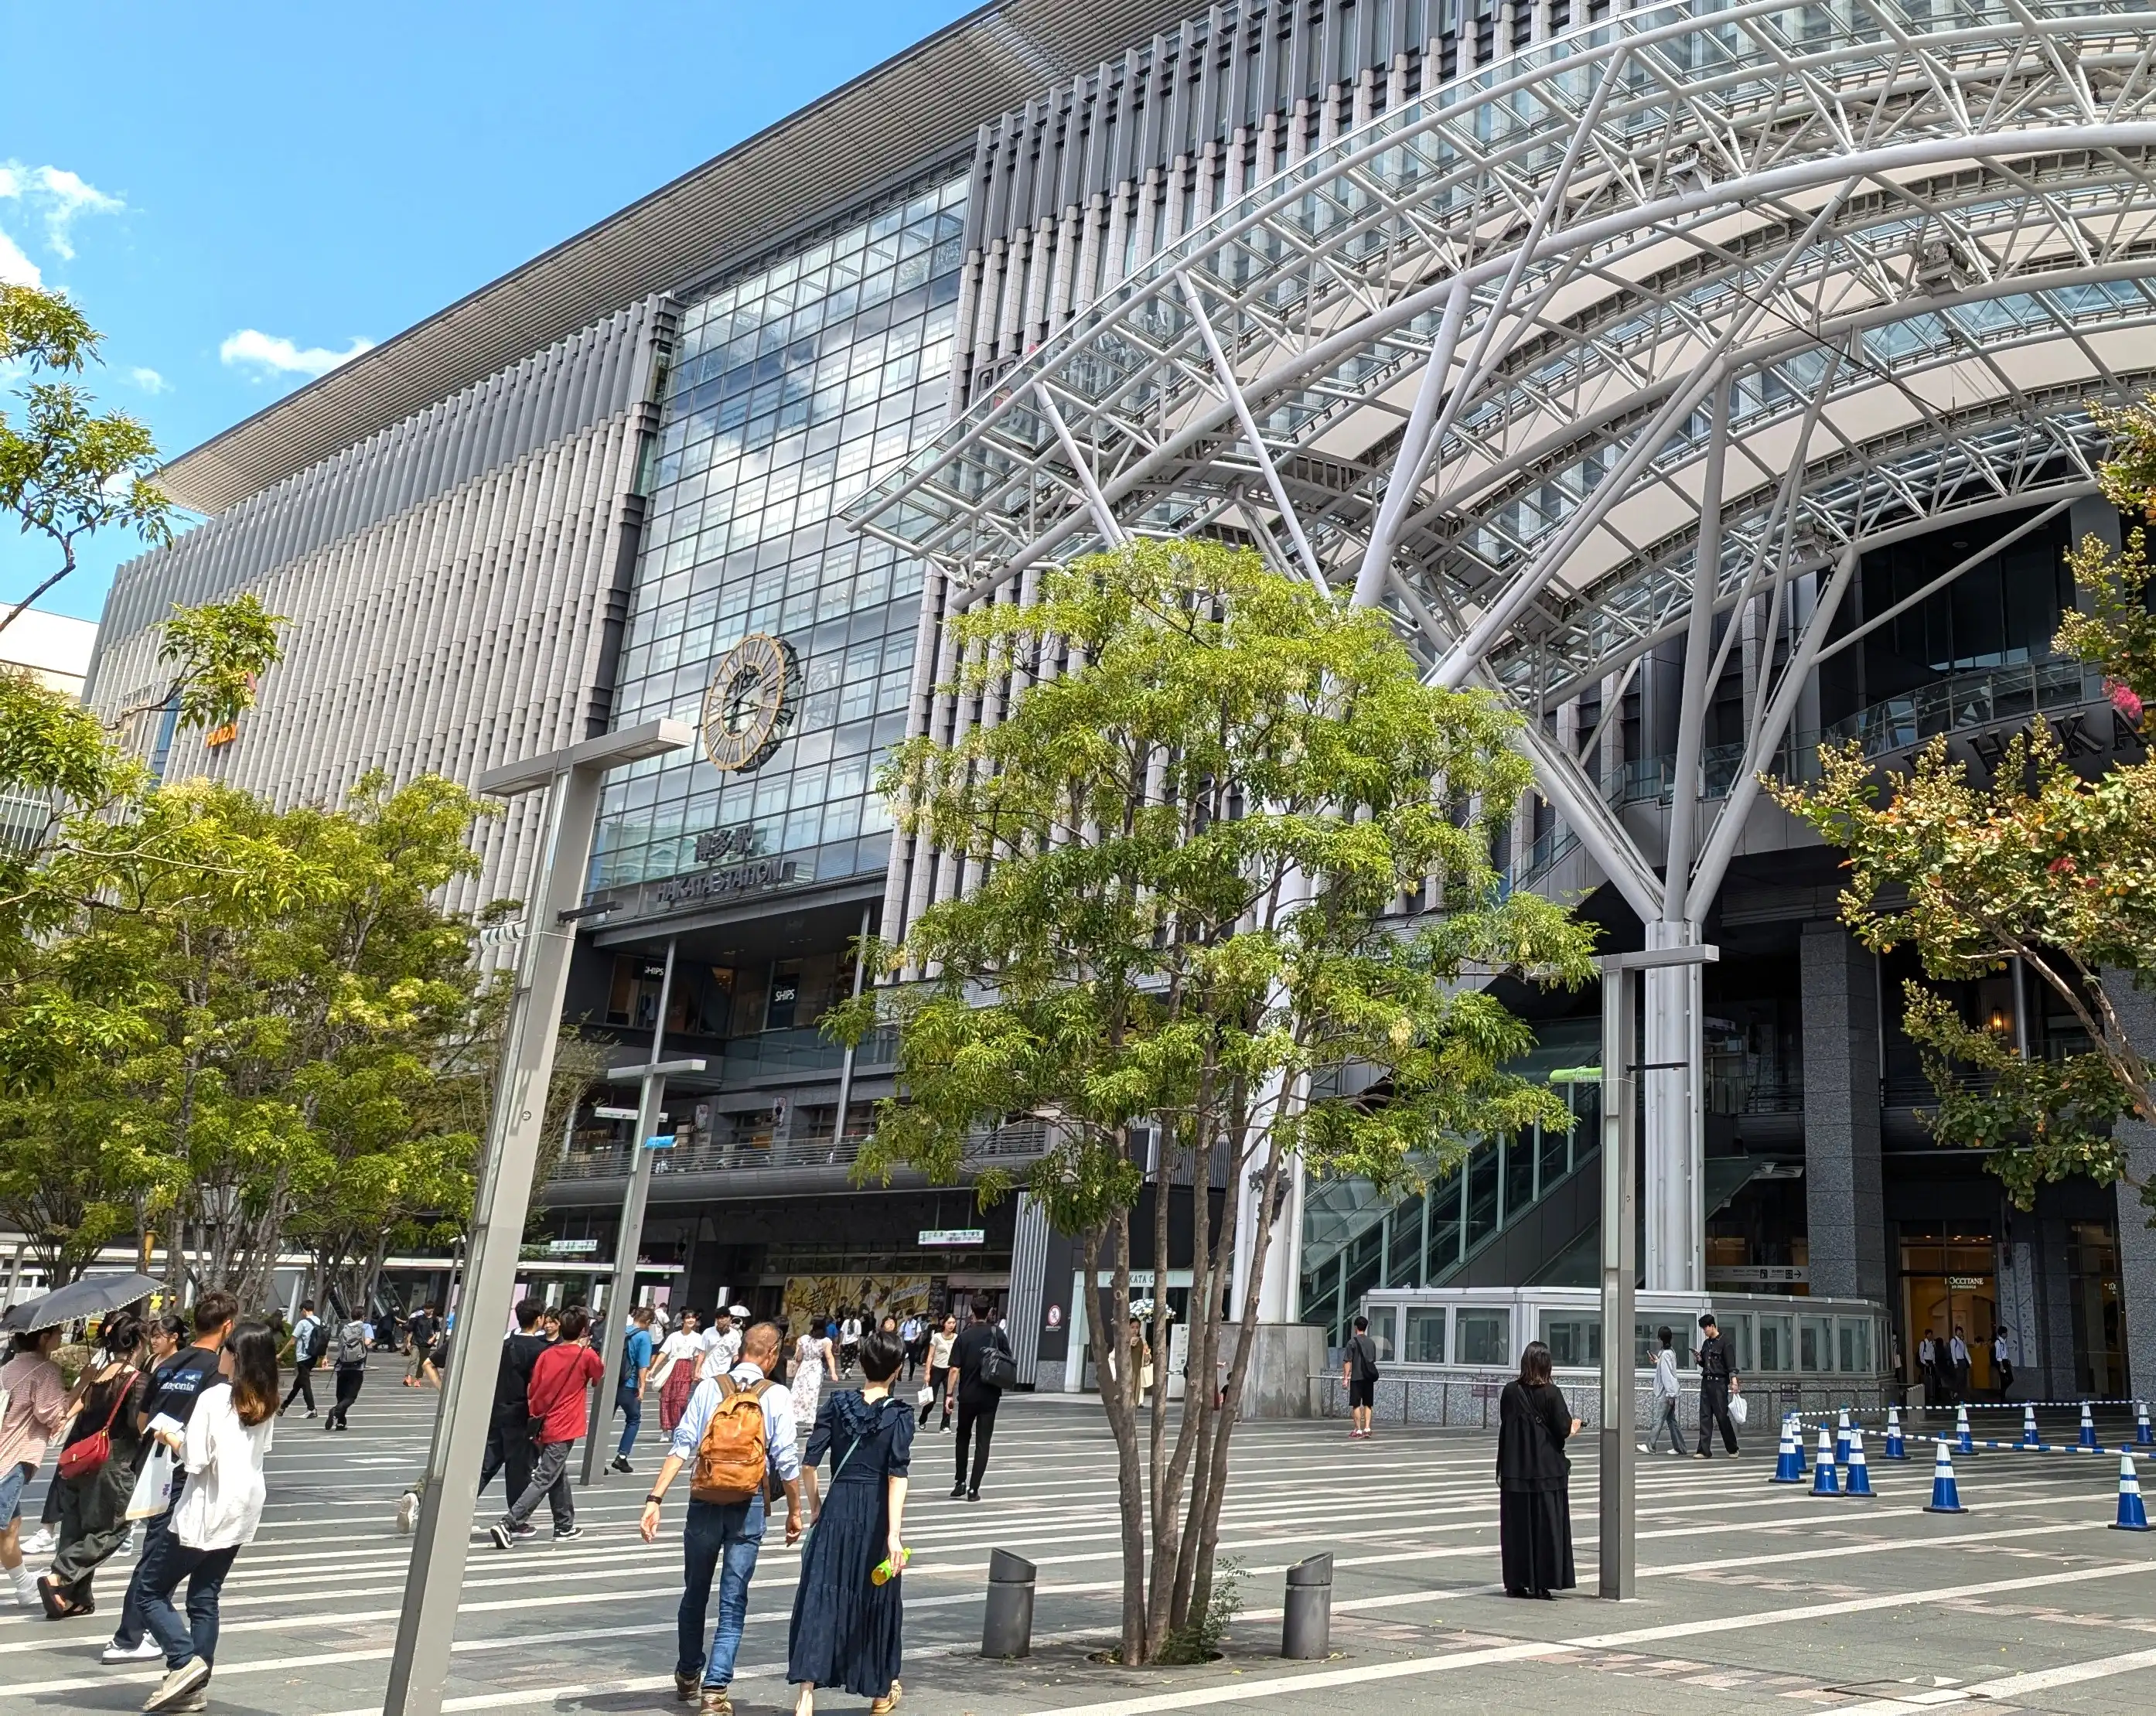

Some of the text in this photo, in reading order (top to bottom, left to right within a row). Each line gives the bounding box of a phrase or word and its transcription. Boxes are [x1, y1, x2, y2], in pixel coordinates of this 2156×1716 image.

[1967, 704, 2156, 776] HAKA
[694, 824, 755, 863] 博多駅
[657, 859, 783, 902] HAKATA STATION
[774, 988, 795, 1001] SHIPS
[1109, 1274, 1147, 1284] KATA
[1944, 1276, 1984, 1284] LOCCITANE
